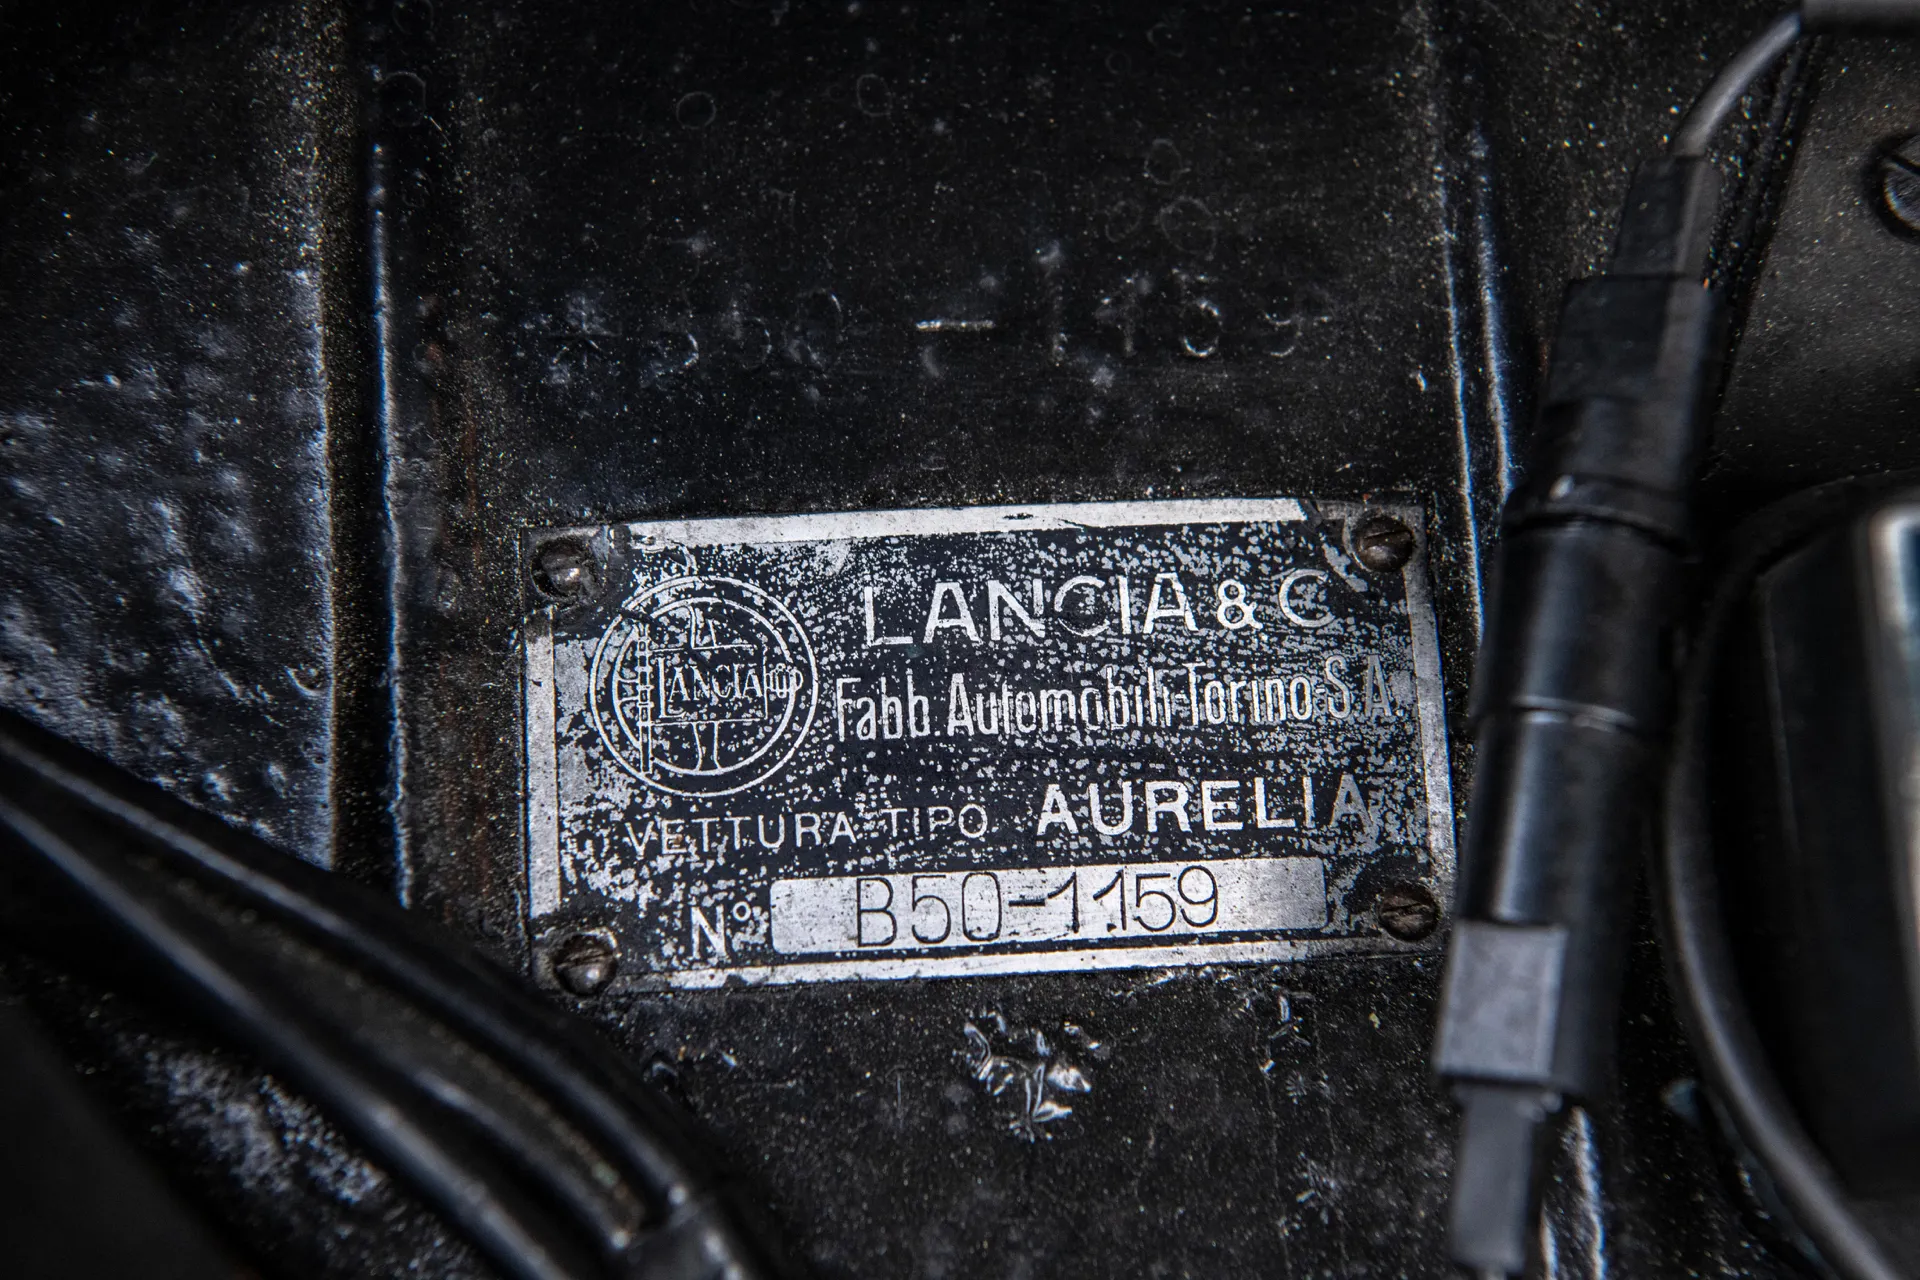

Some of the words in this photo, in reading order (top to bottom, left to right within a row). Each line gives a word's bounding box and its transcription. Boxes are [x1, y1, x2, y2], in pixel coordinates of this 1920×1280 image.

[863, 572, 1200, 646] LANCIA
[1216, 579, 1264, 629] &
[657, 656, 764, 719] LANCIA
[625, 814, 857, 856] VETTURA
[883, 803, 987, 839] TIPO
[1036, 773, 1376, 837] AURELIA
